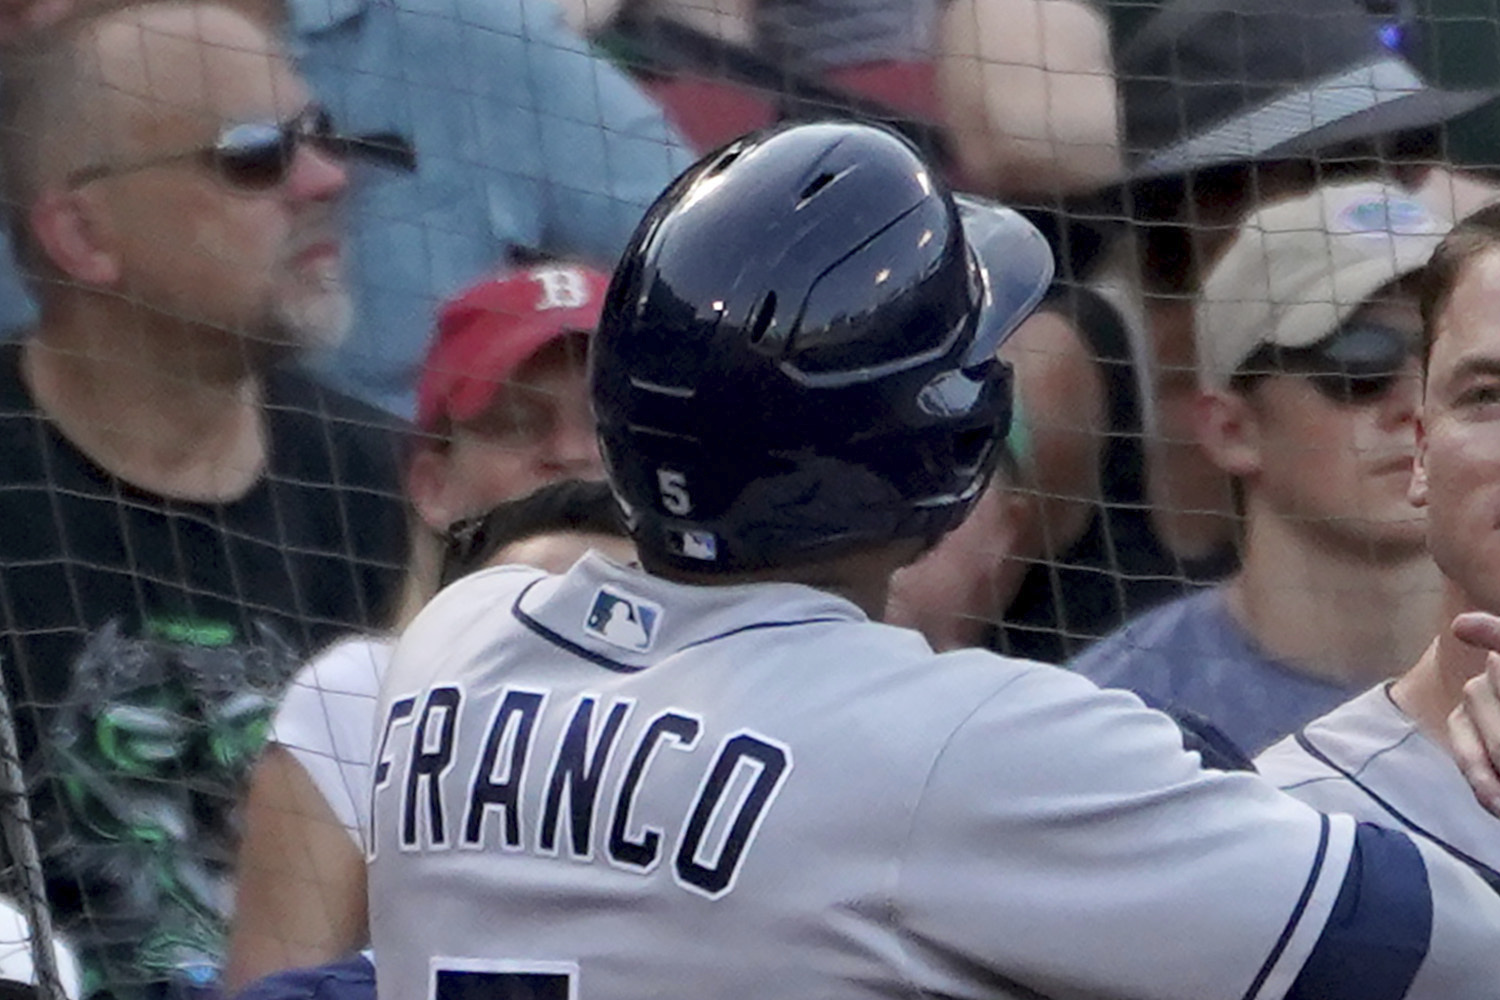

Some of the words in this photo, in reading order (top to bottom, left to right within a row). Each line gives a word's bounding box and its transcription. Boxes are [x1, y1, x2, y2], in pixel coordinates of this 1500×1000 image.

[533, 267, 588, 312] B
[656, 468, 692, 516] 5
[366, 681, 794, 901] FRANCO
